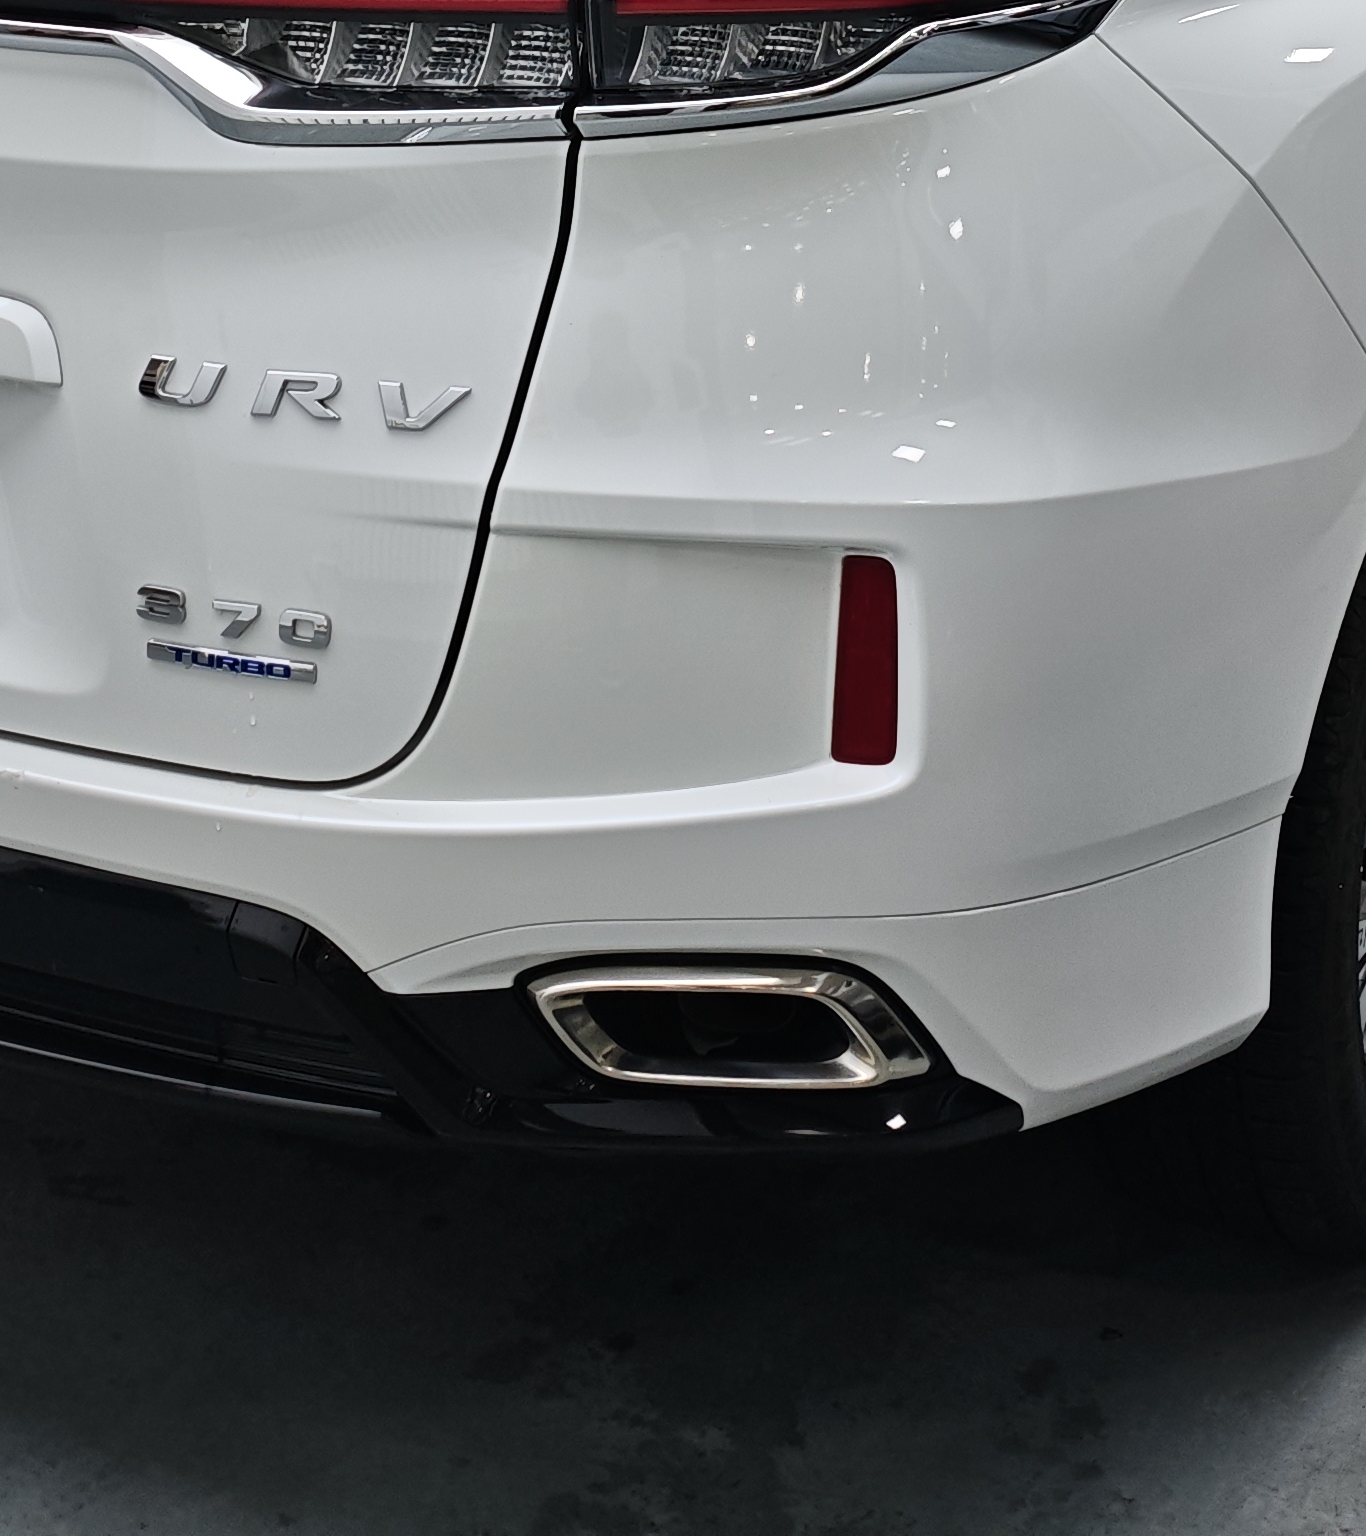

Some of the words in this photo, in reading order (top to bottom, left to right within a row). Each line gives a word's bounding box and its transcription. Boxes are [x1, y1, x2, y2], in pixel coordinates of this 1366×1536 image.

[137, 352, 474, 432] URV
[135, 582, 334, 650] 370
[164, 645, 293, 682] TURBO
